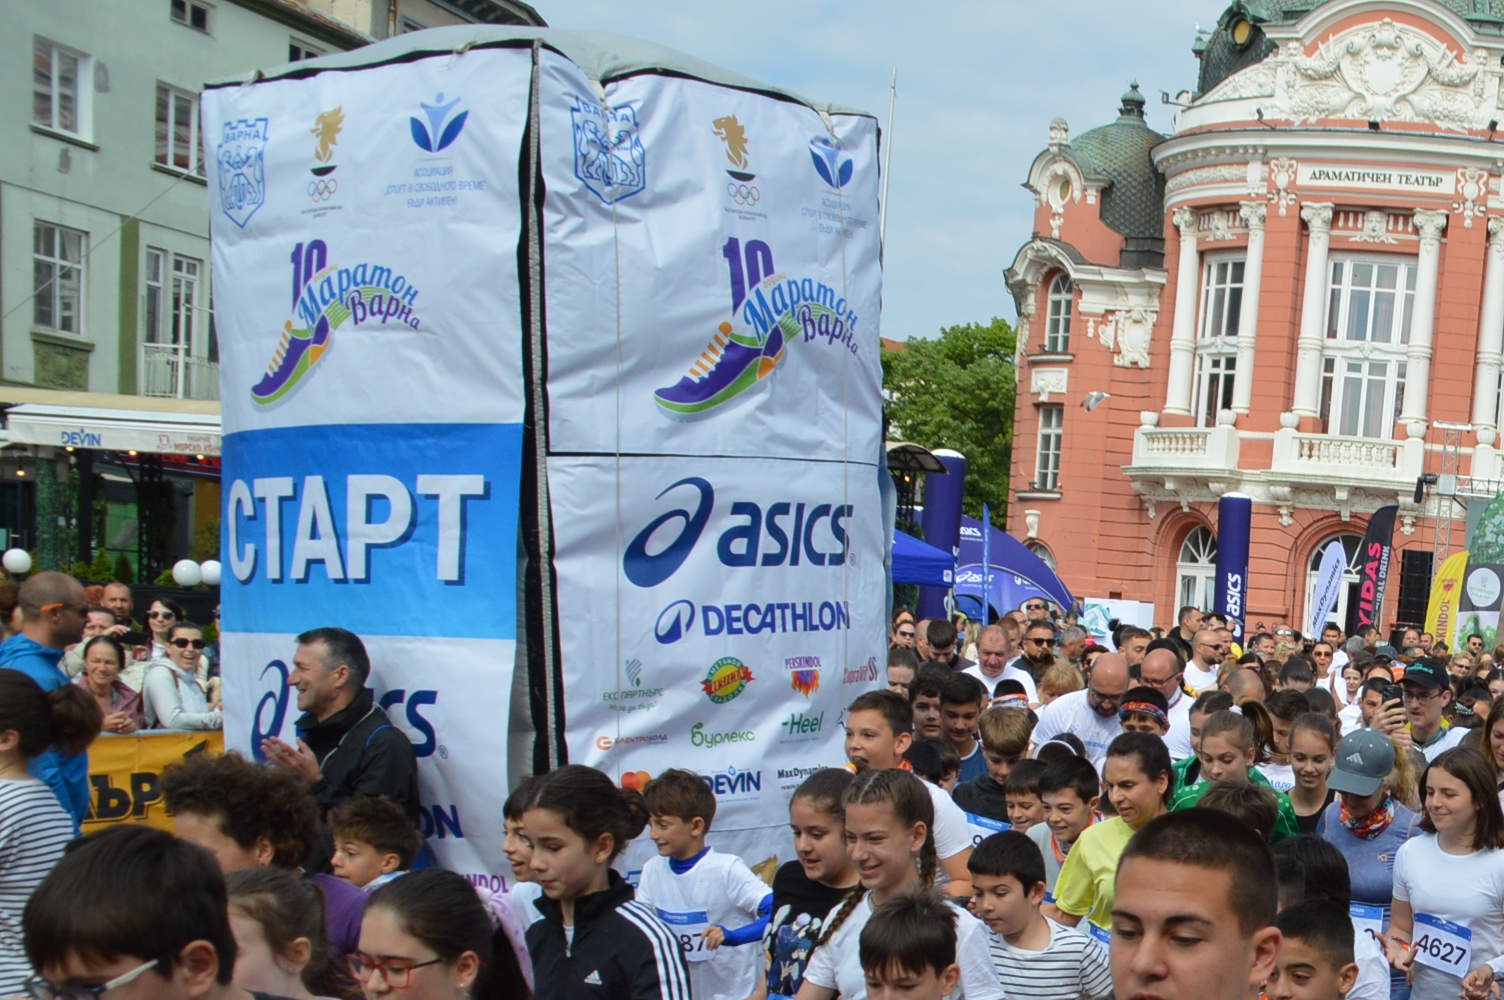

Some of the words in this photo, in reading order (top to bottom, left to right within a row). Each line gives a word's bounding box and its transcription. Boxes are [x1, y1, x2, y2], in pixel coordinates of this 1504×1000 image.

[1309, 168, 1392, 184] ДРАМАТИЧЕН
[1398, 173, 1443, 187] ТЕАТЪР
[290, 239, 328, 313] 10
[299, 262, 419, 331] Маратон
[722, 236, 775, 316] 10
[345, 290, 420, 330] Варна
[744, 277, 858, 343] Маратон
[797, 304, 859, 353] Варна
[61, 431, 101, 446] DEVIN
[227, 473, 489, 585] СТАРТ
[702, 600, 851, 636] DECATHLON
[1418, 934, 1468, 966] 4627
